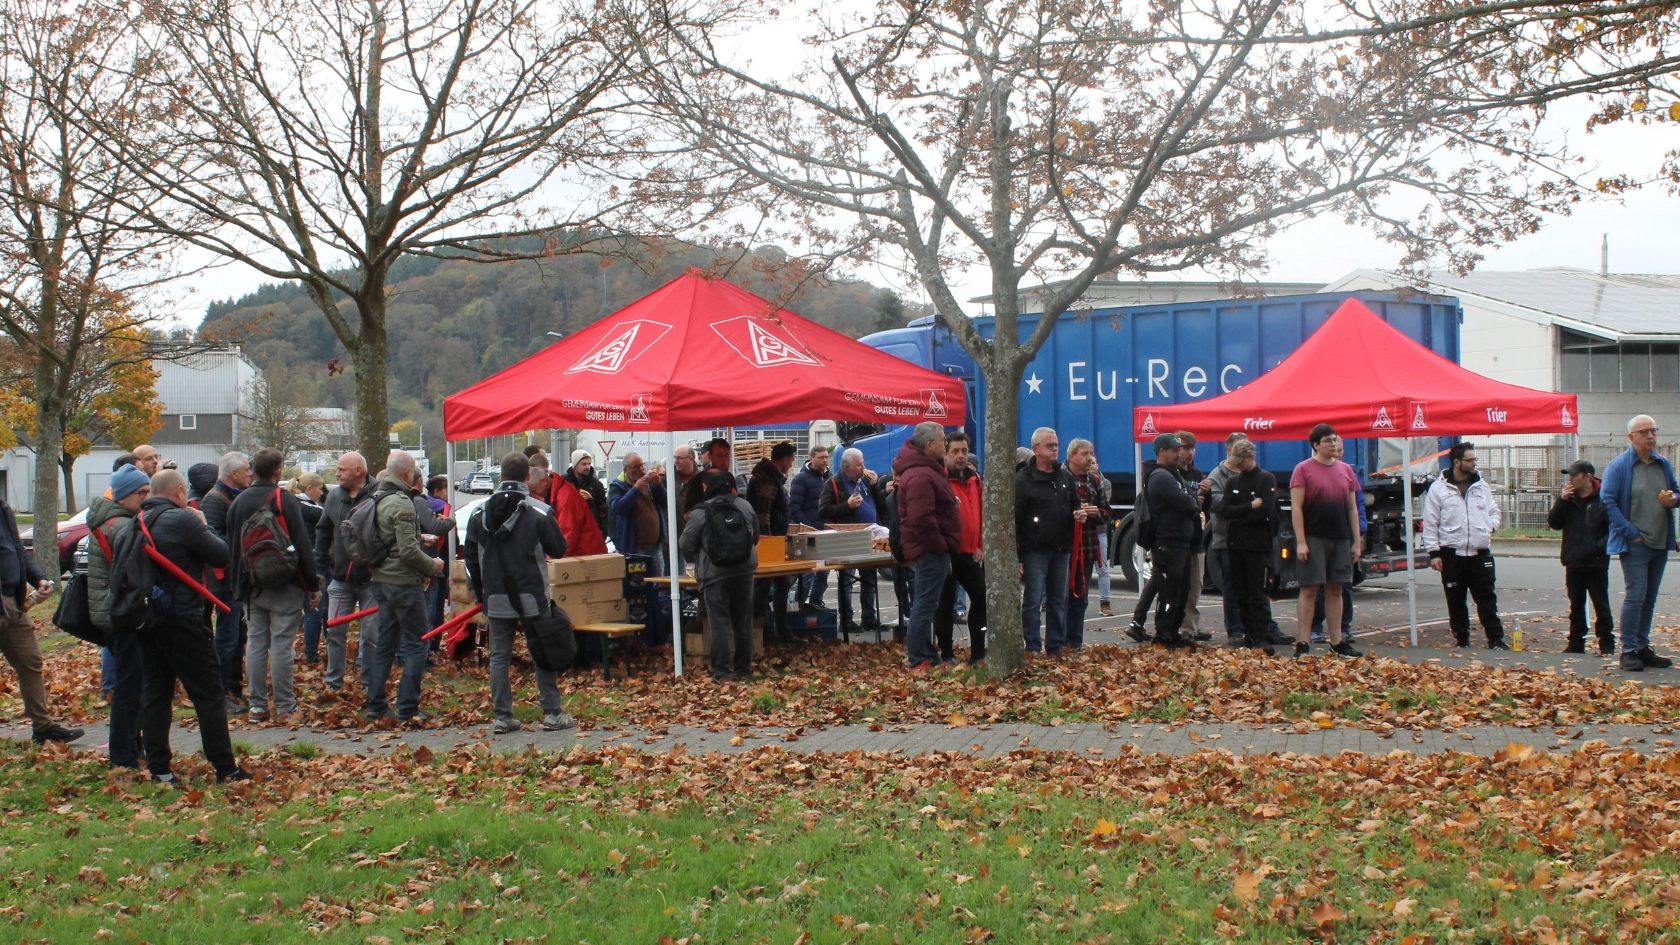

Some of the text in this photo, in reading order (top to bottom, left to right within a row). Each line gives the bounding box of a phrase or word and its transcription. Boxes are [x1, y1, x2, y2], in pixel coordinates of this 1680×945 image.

[586, 411, 625, 421] GUTES LEBEN
[874, 405, 920, 416] GUTES LEBEN
[1486, 407, 1508, 423] Trier
[1243, 417, 1276, 430] Trier
[637, 439, 666, 447] Automob
